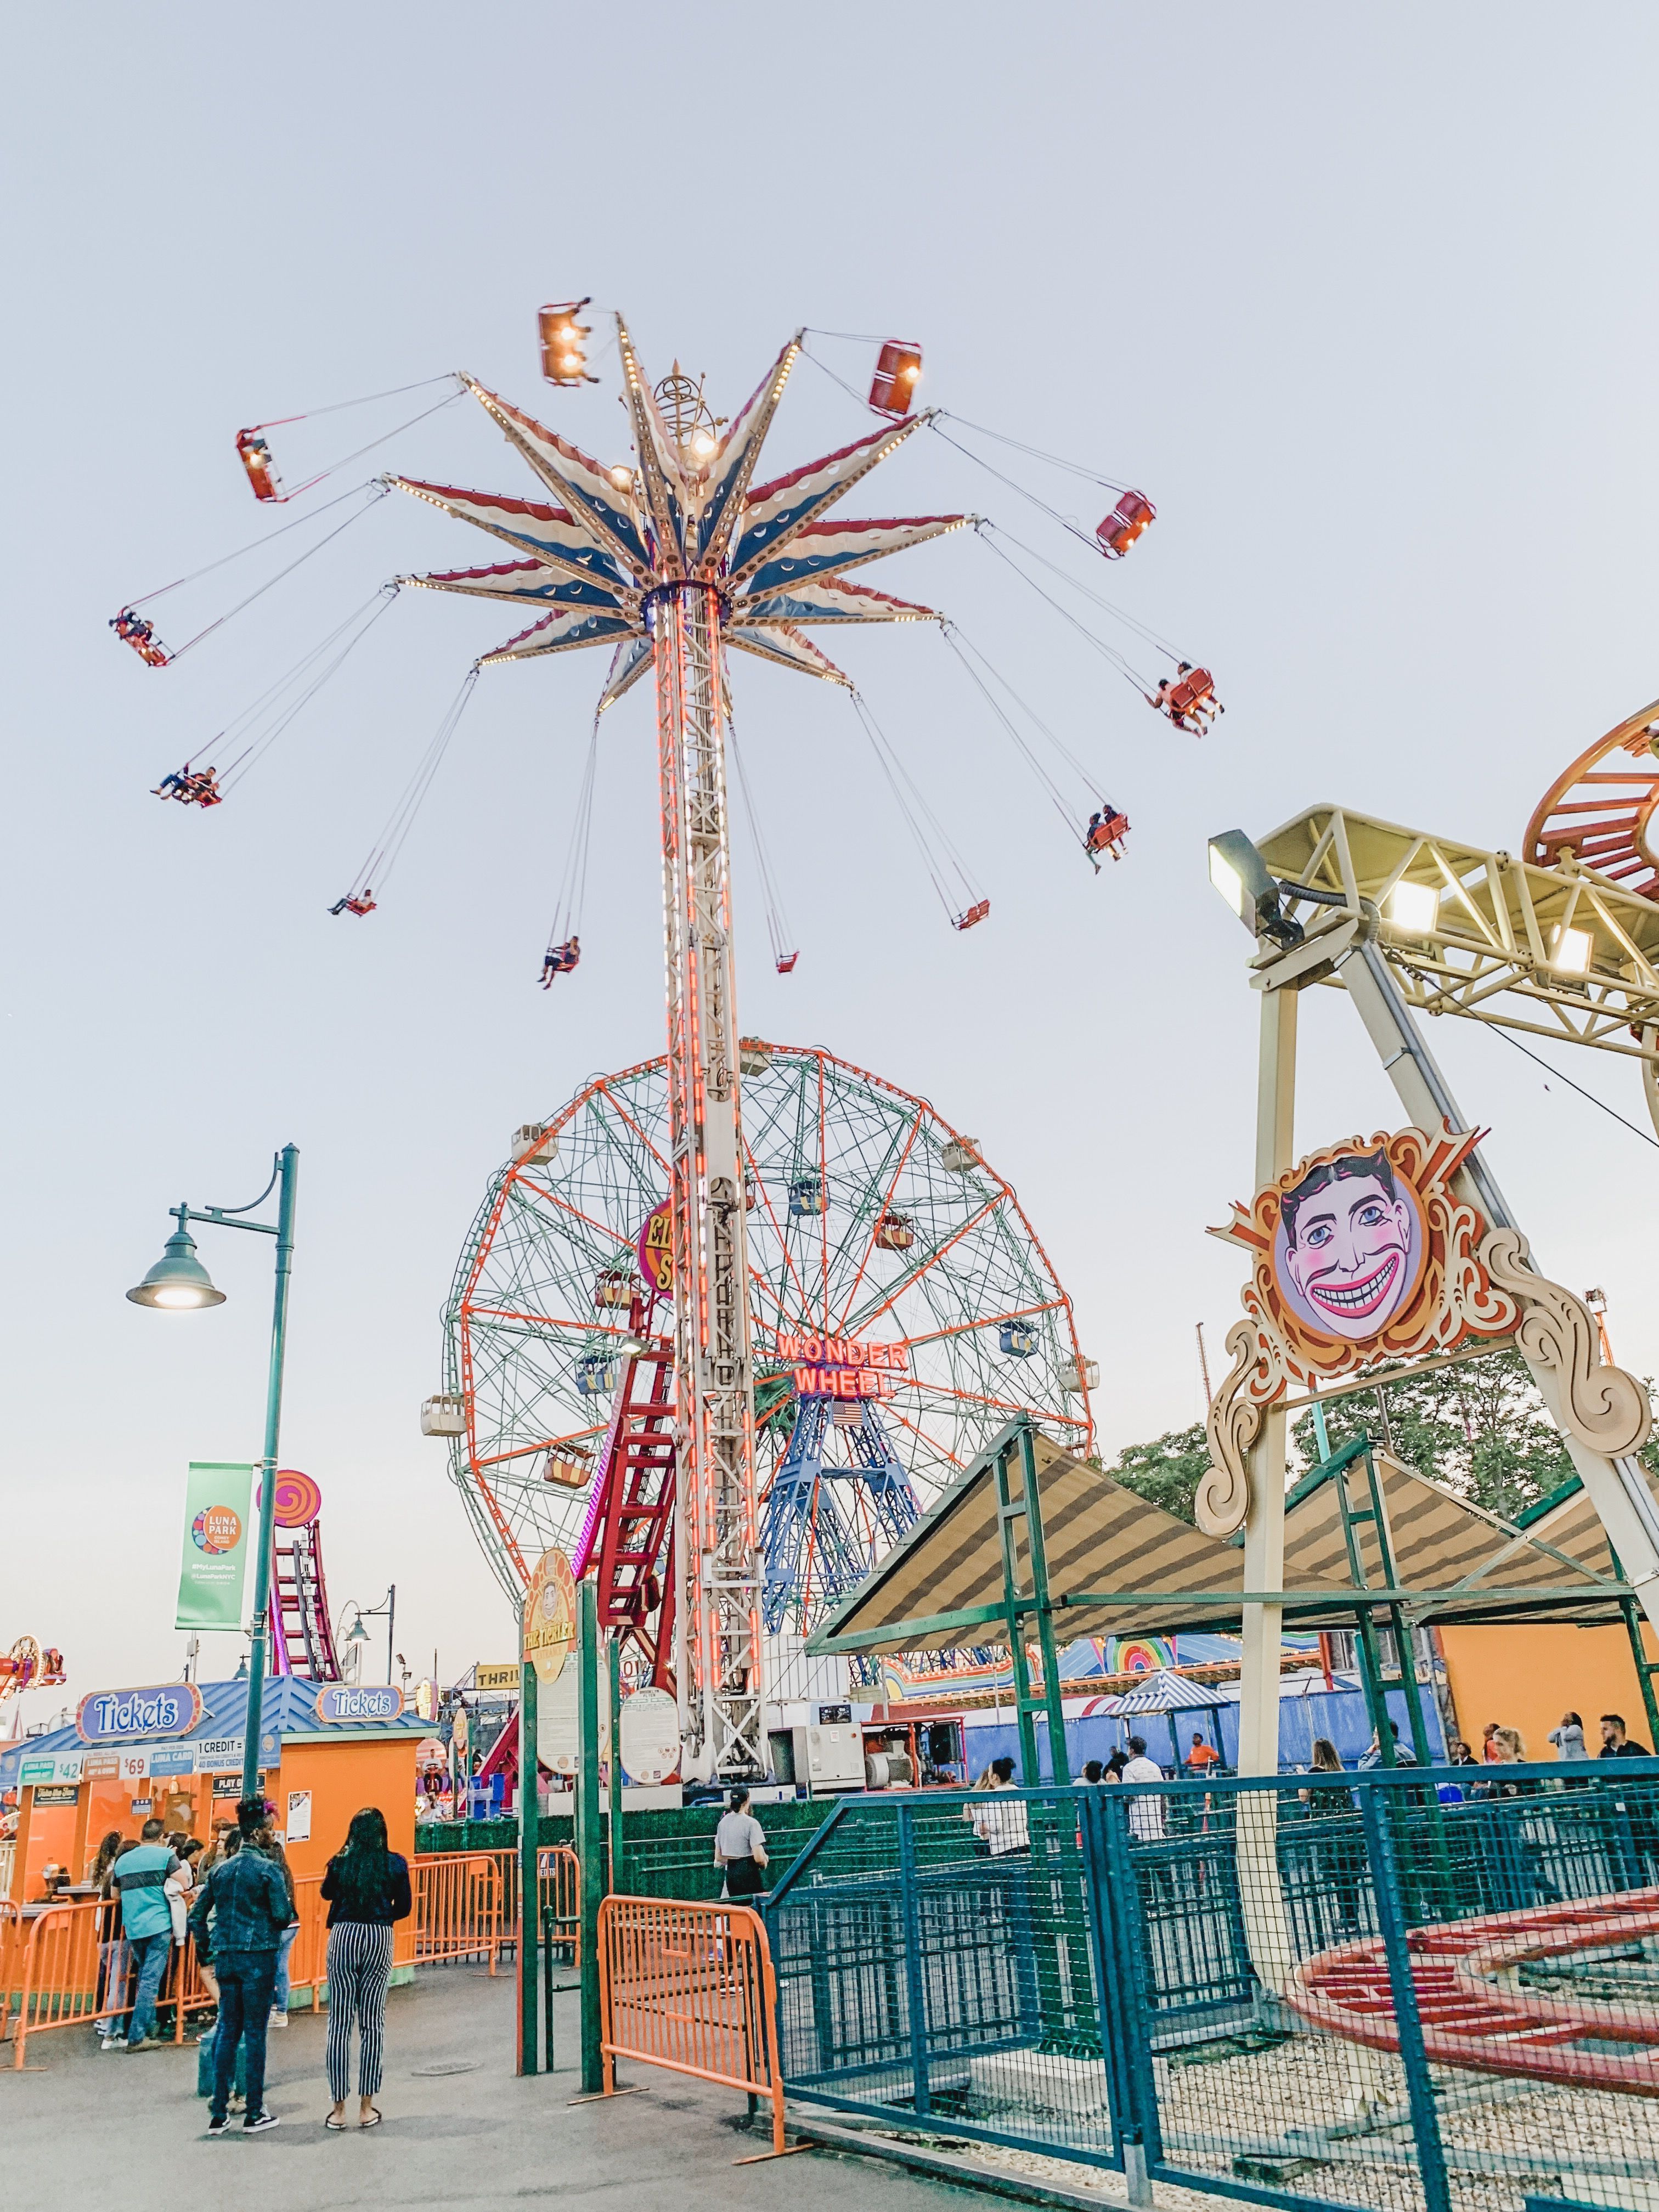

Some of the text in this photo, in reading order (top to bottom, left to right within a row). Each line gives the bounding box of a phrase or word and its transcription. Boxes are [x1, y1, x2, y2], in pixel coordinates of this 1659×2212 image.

[777, 1335, 909, 1370] WONDER
[794, 1368, 896, 1397] WHEEL
[209, 1516, 236, 1526] LUNA
[208, 1525, 236, 1535] PARK
[523, 1621, 575, 1651] THE TICKLER
[332, 1689, 391, 1718] Tickets
[94, 1693, 178, 1734] Tickets
[199, 1743, 202, 1753] 1
[205, 1740, 235, 1753] CREDIT
[151, 1751, 193, 1763] LUNA CARD
[206, 1759, 224, 1768] BONUS
[225, 1758, 244, 1766] CREDIT
[59, 1763, 78, 1779] $42
[124, 1758, 144, 1775] $69
[218, 1779, 236, 1788] PLAY
